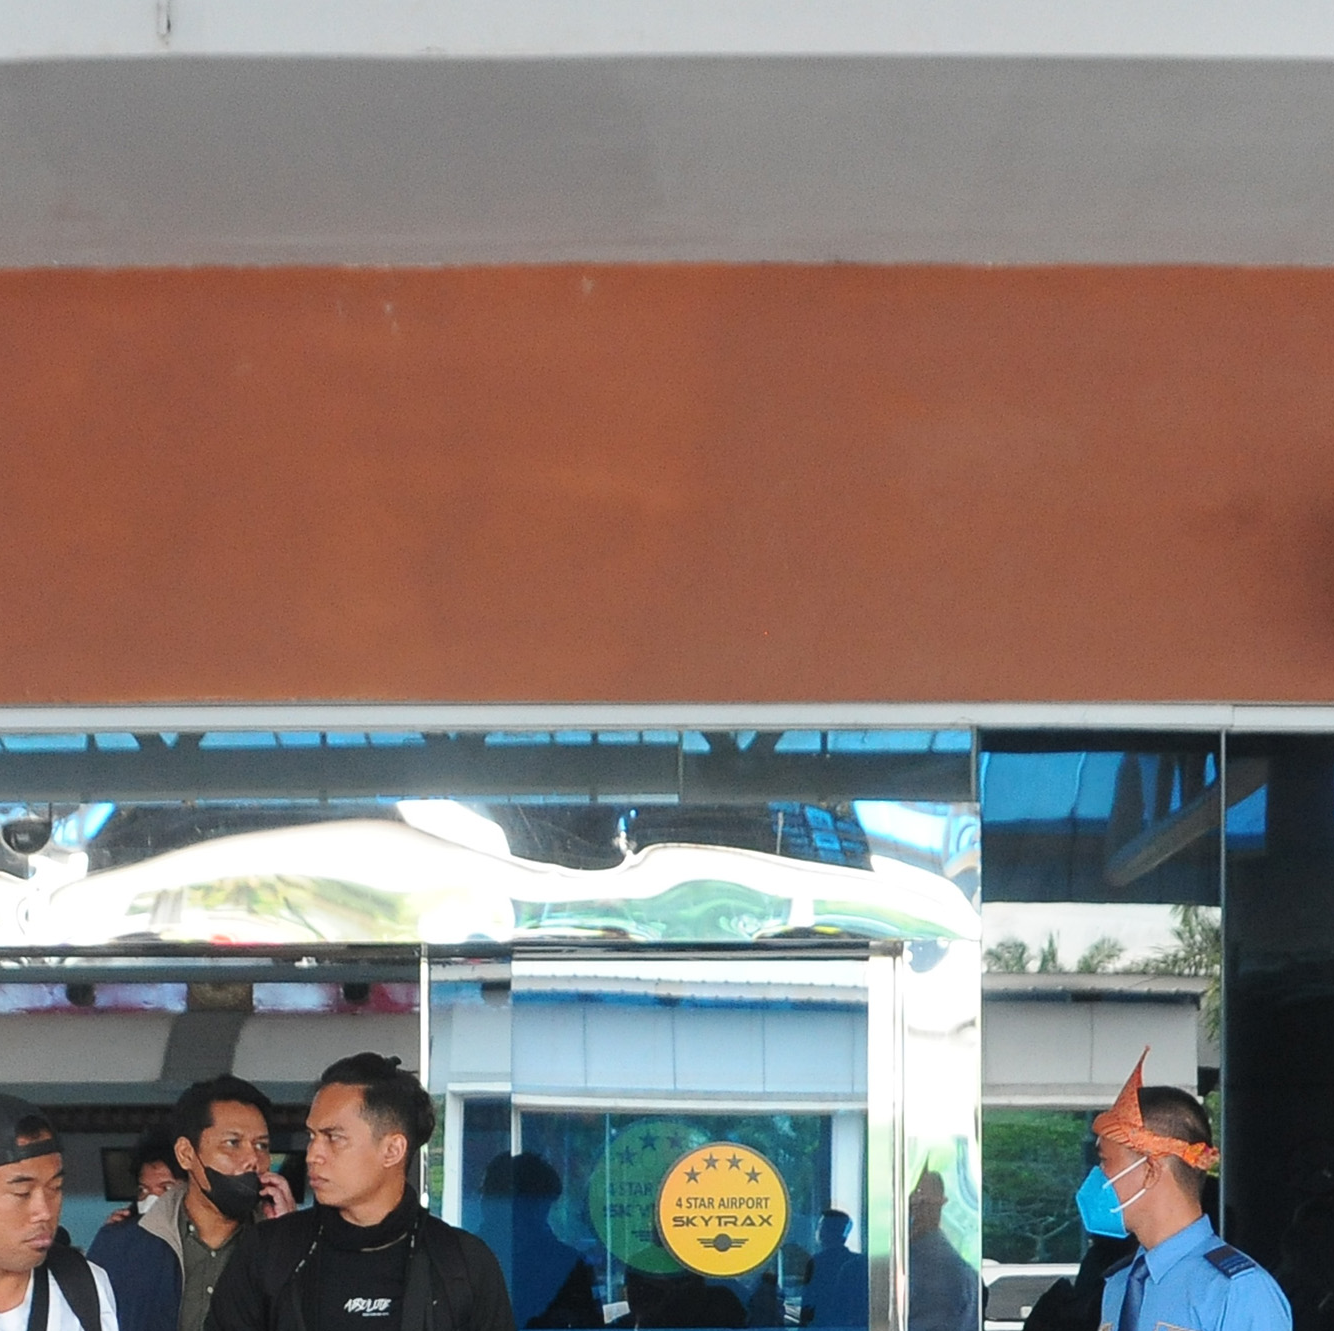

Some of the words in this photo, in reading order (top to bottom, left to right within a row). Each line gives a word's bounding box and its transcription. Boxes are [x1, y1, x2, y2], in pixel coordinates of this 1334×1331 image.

[675, 1197, 683, 1209] 4
[686, 1197, 715, 1209] STAR
[718, 1196, 770, 1210] AIRPORT
[672, 1214, 773, 1227] SKYTRAX
